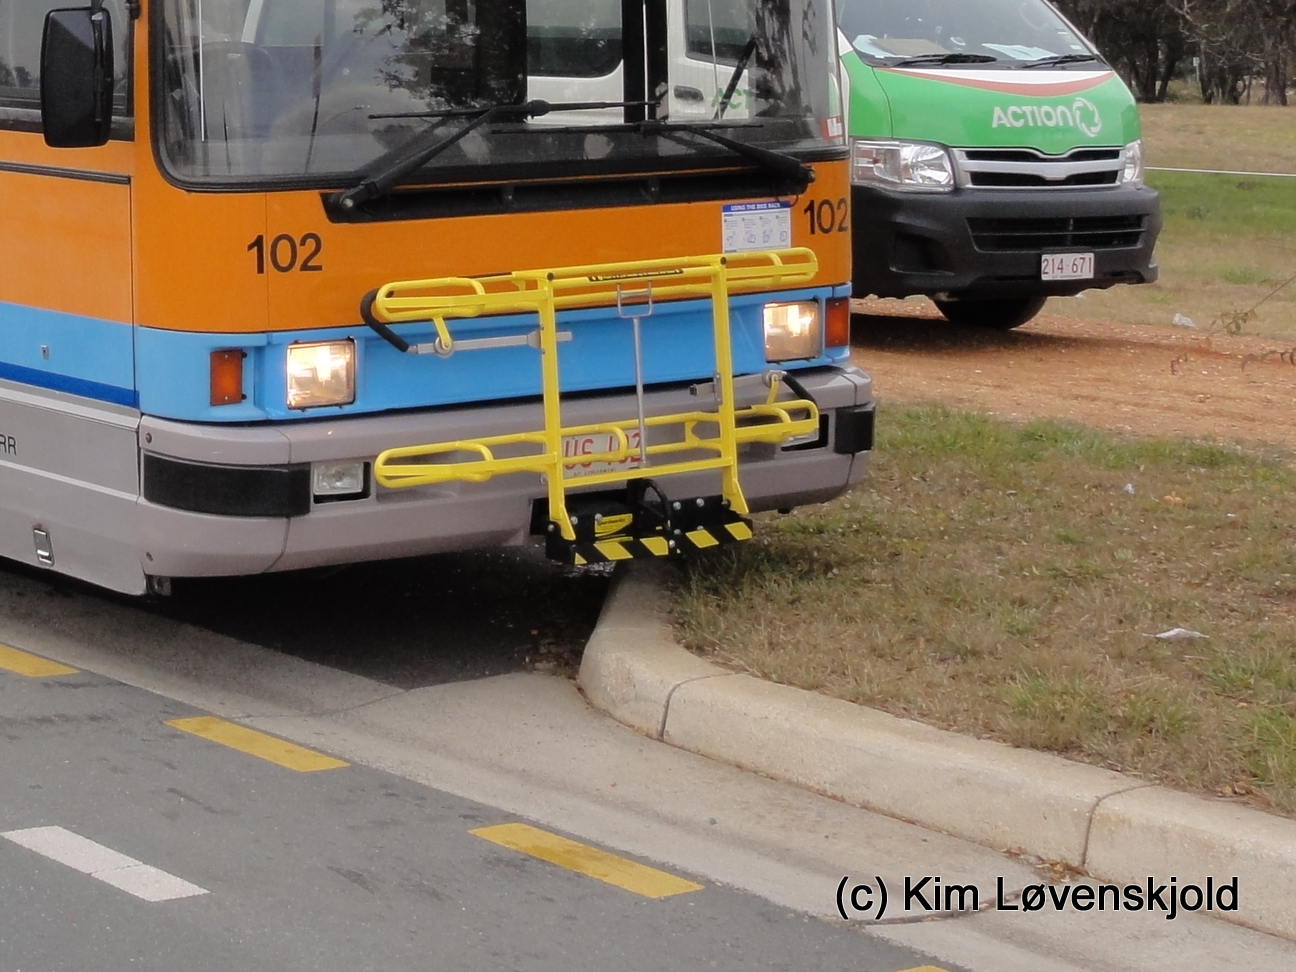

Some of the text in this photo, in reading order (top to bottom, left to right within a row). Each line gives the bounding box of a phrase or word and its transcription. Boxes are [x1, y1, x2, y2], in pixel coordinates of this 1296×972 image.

[991, 105, 1074, 128] ACTION
[804, 197, 848, 235] 102
[247, 232, 323, 275] 102
